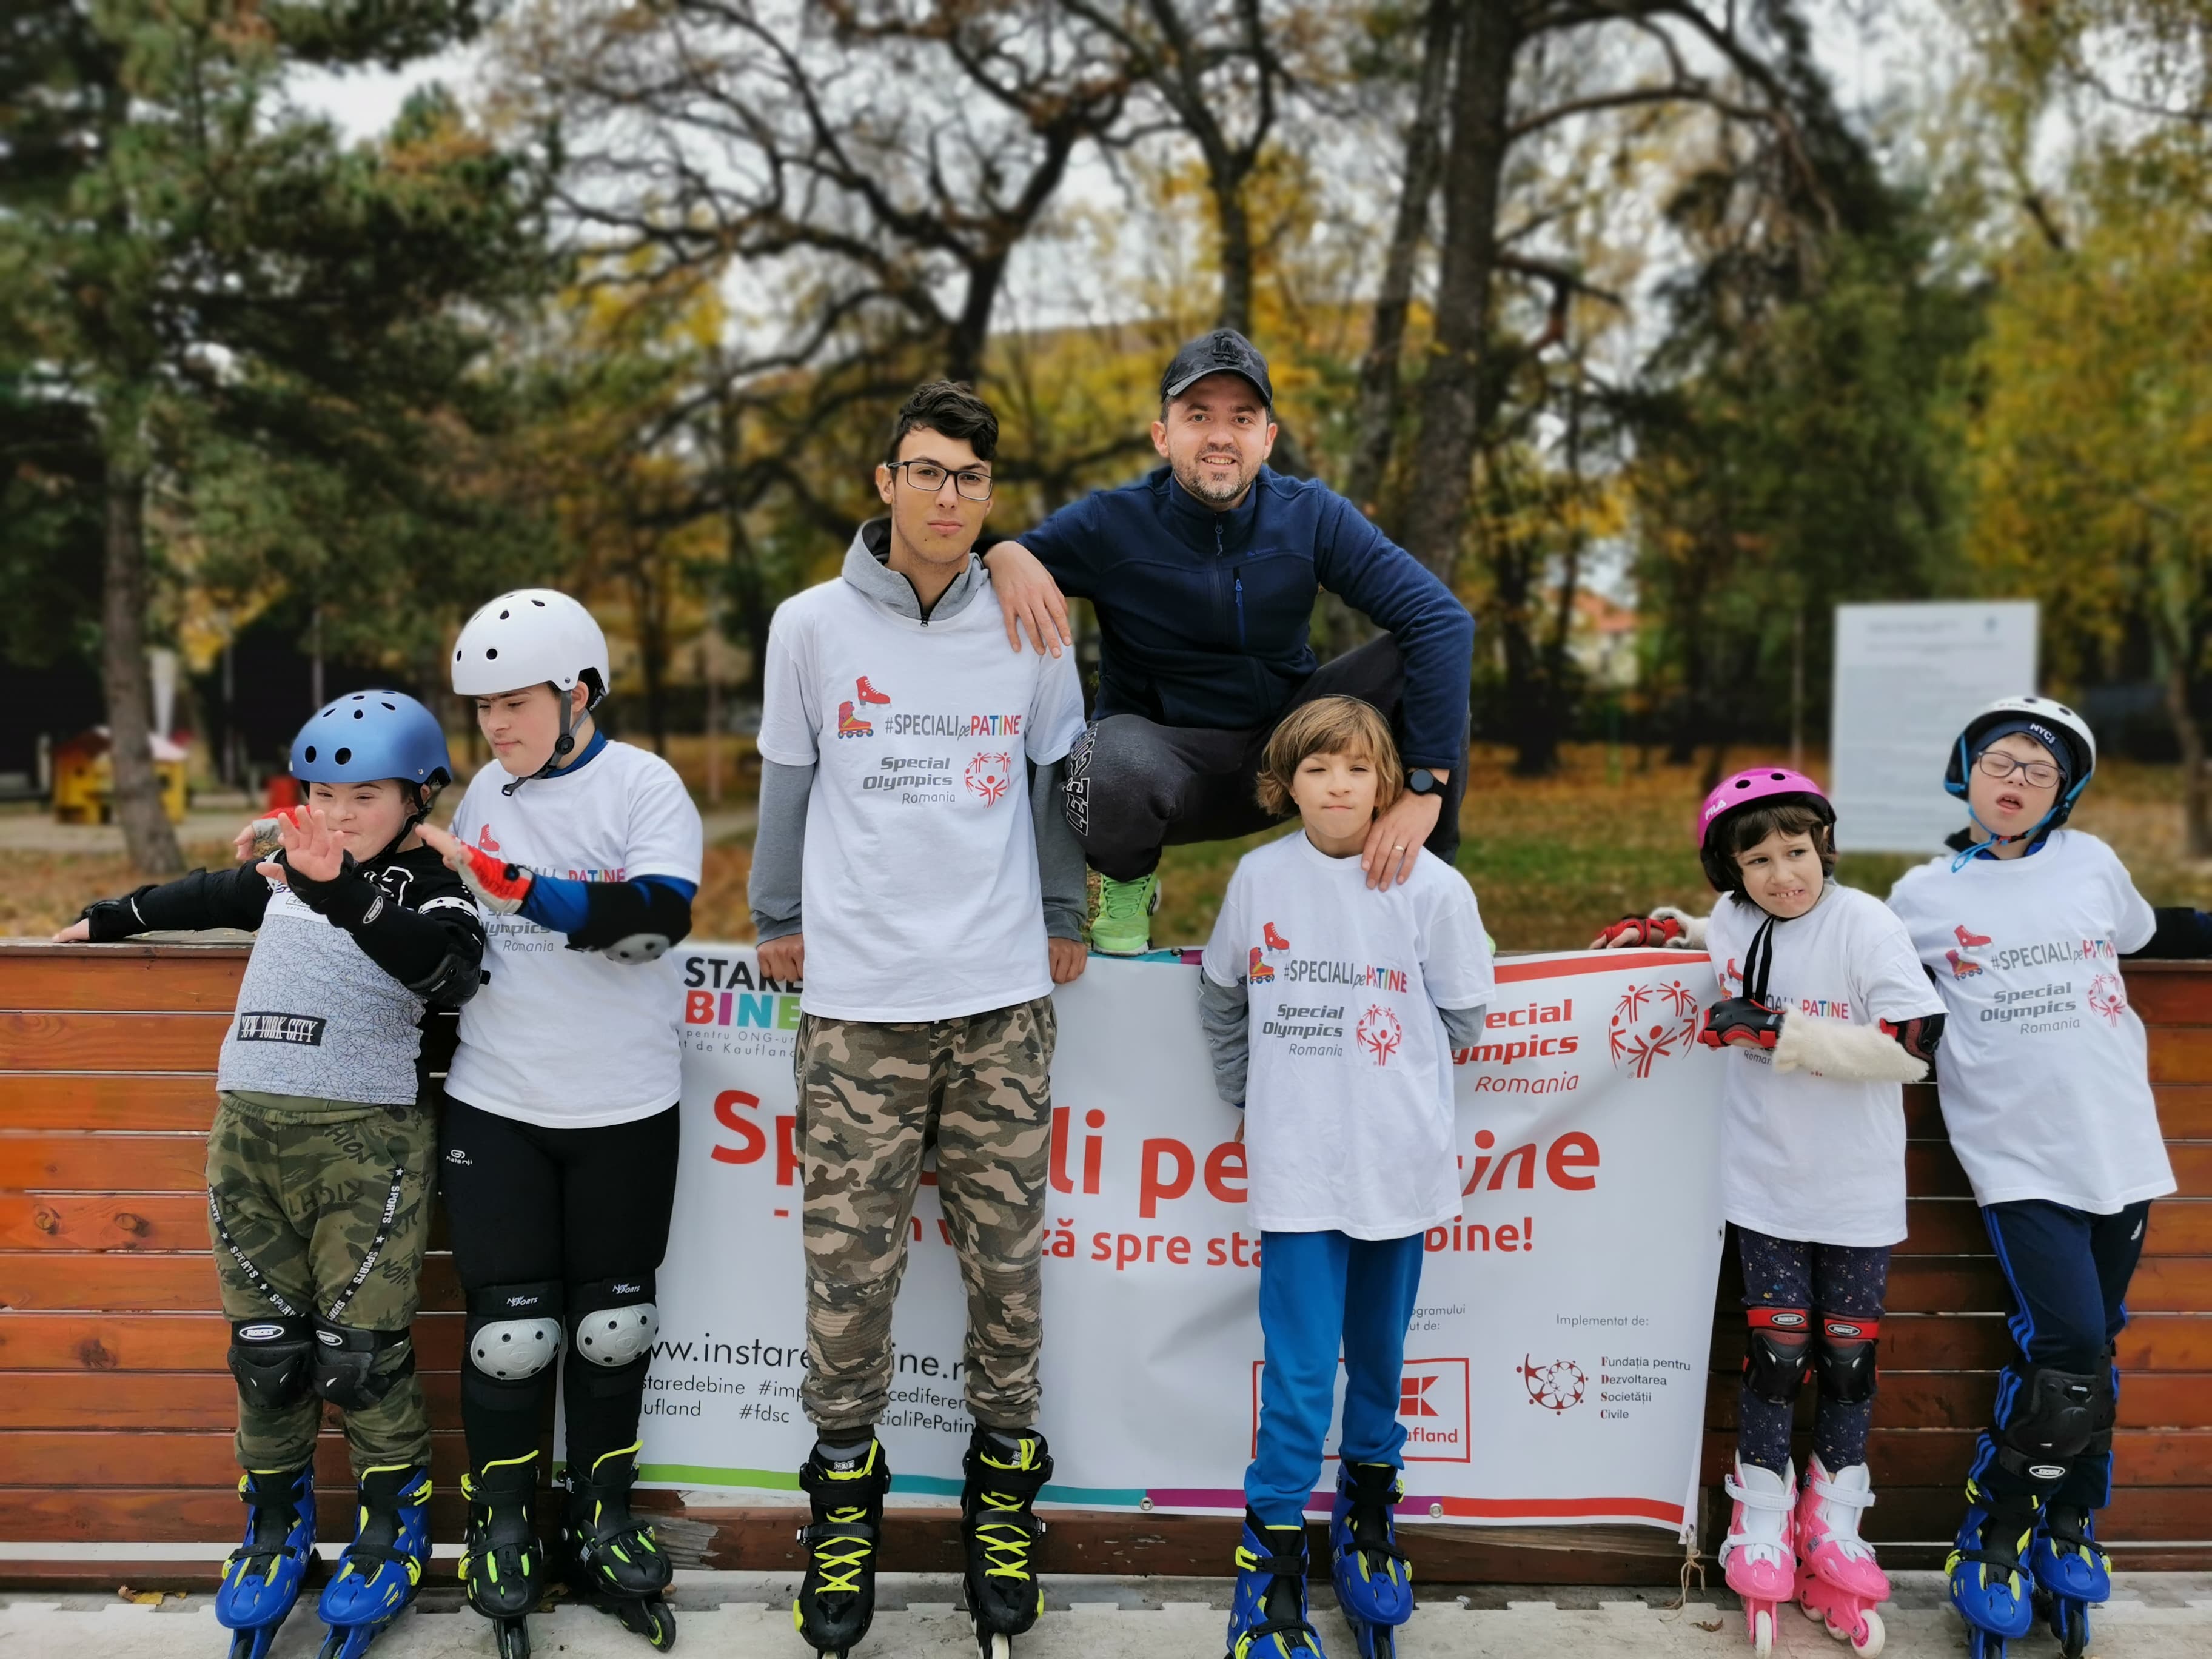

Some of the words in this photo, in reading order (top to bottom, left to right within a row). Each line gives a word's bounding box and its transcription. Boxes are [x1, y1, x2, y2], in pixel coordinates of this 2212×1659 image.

[880, 757, 950, 772] Special
[863, 774, 953, 791] Olympics
[902, 791, 956, 805] Romania
[1705, 800, 1727, 820] FILA
[503, 940, 554, 953] Romania
[1993, 982, 2071, 1005] Special
[685, 990, 800, 1030] BINE
[1277, 1004, 1344, 1020] Special
[1485, 998, 1572, 1029] ecial
[1980, 1000, 2077, 1022] Olympics
[260, 1016, 287, 1040] YORK
[287, 1018, 318, 1043] CITY
[1262, 1021, 1343, 1039] Olympics
[2020, 1016, 2080, 1035] Romania
[686, 1029, 730, 1041] pentru
[696, 1041, 713, 1052] de
[1289, 1043, 1343, 1057] Romania
[1452, 1034, 1579, 1065] ympics
[1474, 1071, 1580, 1094] Romania
[1139, 1137, 1248, 1219] pe
[381, 1185, 400, 1224] SPORTS
[1091, 1231, 1191, 1271] spre
[230, 1245, 260, 1279] SPORTS
[352, 1250, 379, 1285] SPORTS
[1423, 1319, 1441, 1331] de:
[1557, 1313, 1628, 1328] Implementat
[1631, 1314, 1649, 1326] de:
[1601, 1356, 1649, 1370] Fundația
[1652, 1359, 1691, 1372] pentru
[1601, 1373, 1667, 1386] Dezvoltarea
[1600, 1391, 1652, 1405] Societății
[643, 1398, 701, 1416] ufland
[739, 1403, 789, 1423] #fdsc
[1600, 1409, 1629, 1420] Civile
